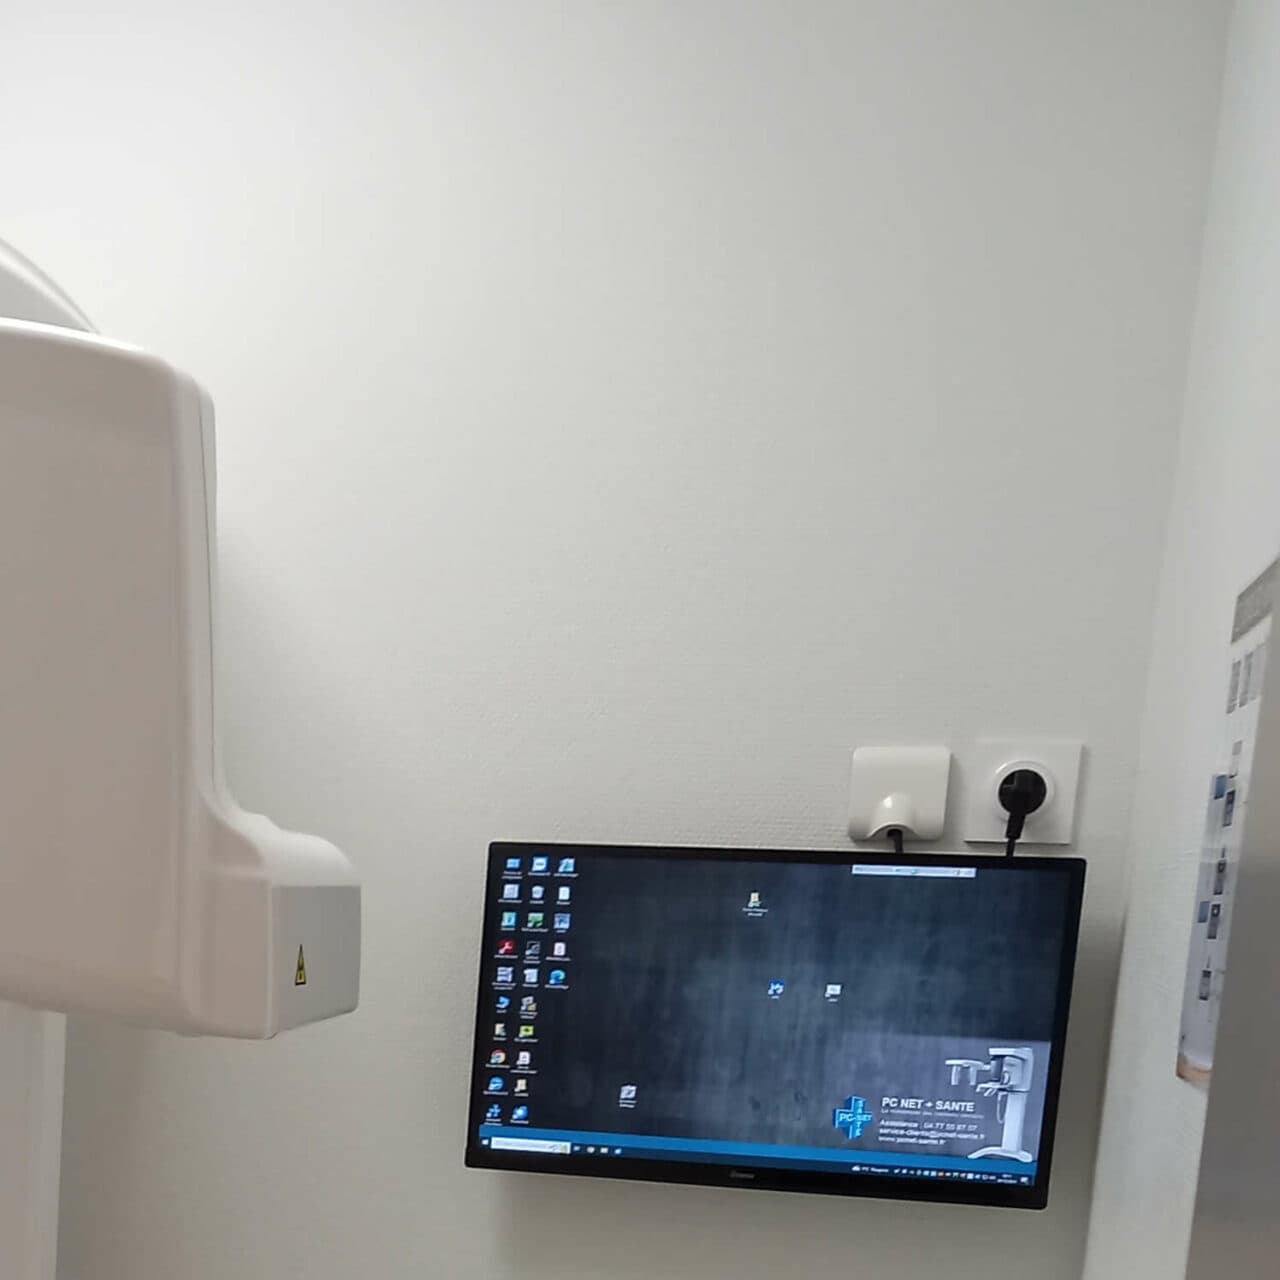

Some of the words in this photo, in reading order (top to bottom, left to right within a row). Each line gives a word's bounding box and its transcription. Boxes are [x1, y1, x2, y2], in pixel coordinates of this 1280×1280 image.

[882, 1097, 898, 1108] PC
[900, 1098, 924, 1109] NET
[935, 1100, 975, 1111] SANTE
